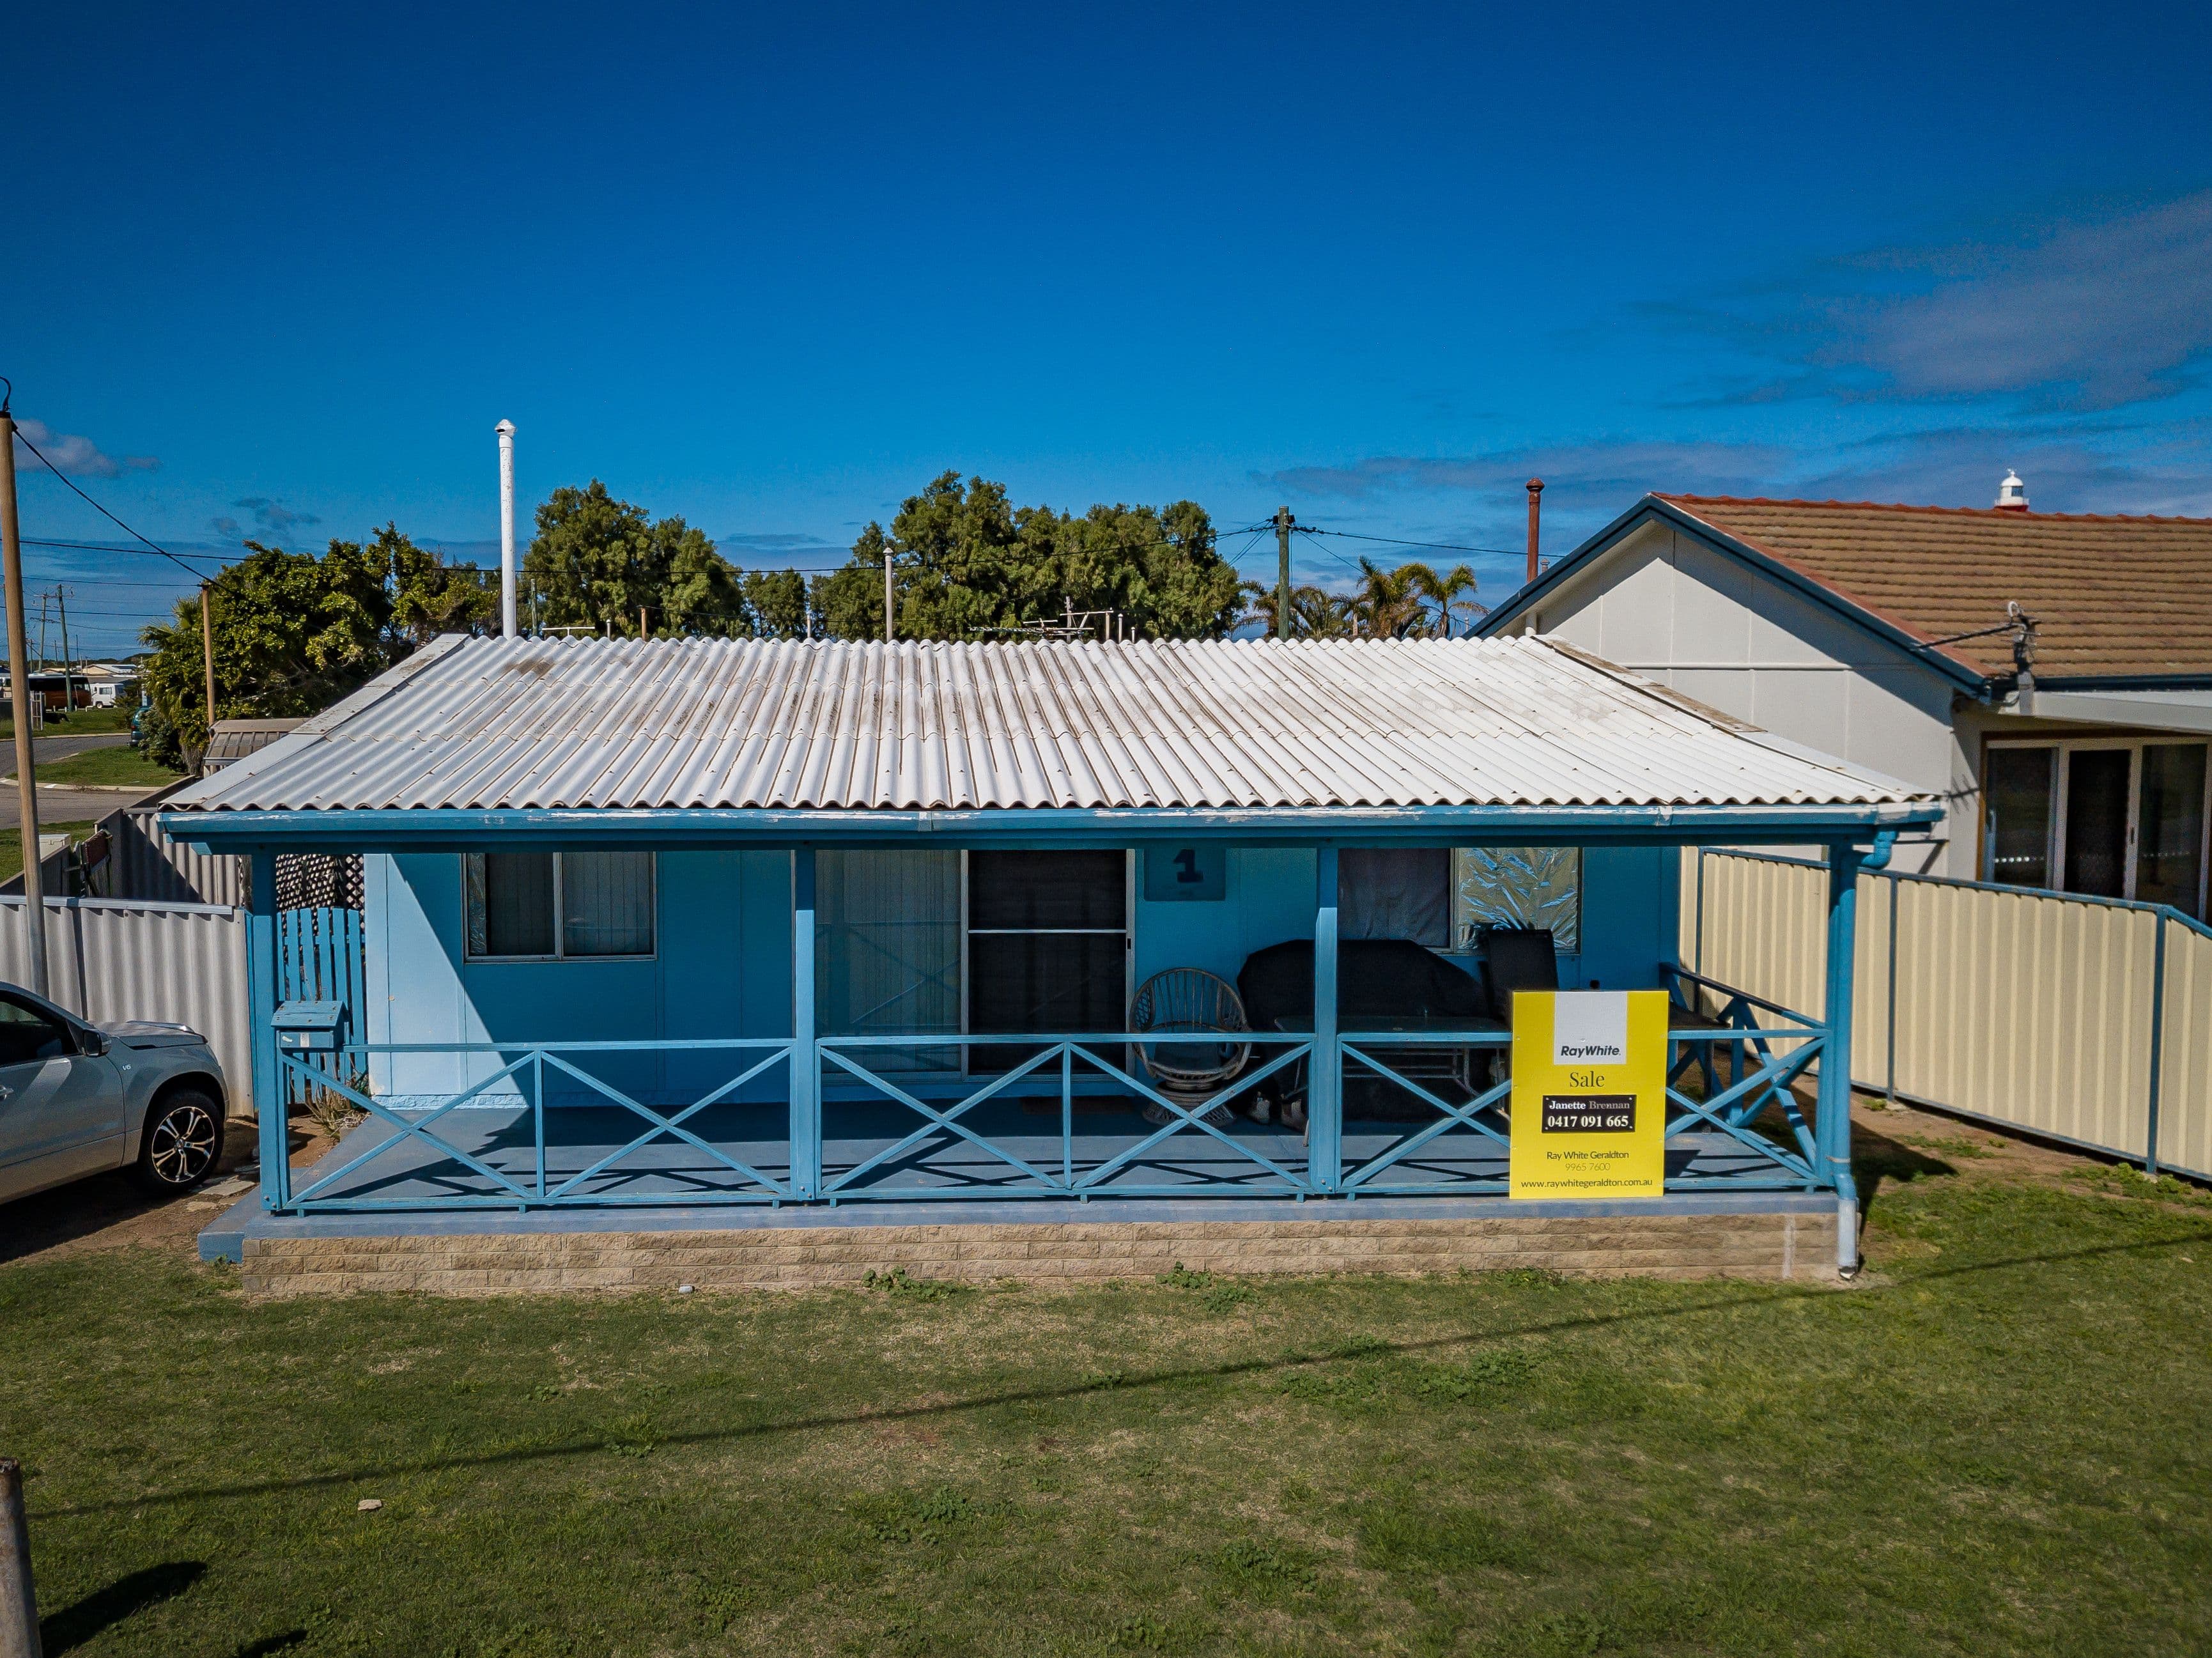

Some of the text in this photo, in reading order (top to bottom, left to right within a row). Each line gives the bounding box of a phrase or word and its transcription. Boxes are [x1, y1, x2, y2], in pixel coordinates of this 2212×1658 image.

[1173, 848, 1203, 883] 1
[1570, 1071, 1605, 1087] Sale
[1549, 1101, 1630, 1109] Janette Brennan
[1547, 1115, 1629, 1127] 0417 091 665
[1547, 1152, 1561, 1160] Ray
[1590, 1151, 1629, 1159] Geraldton
[1565, 1163, 1611, 1171] 9965 7600
[1521, 1179, 1653, 1189] www.raywhitegeraldton.com.au
